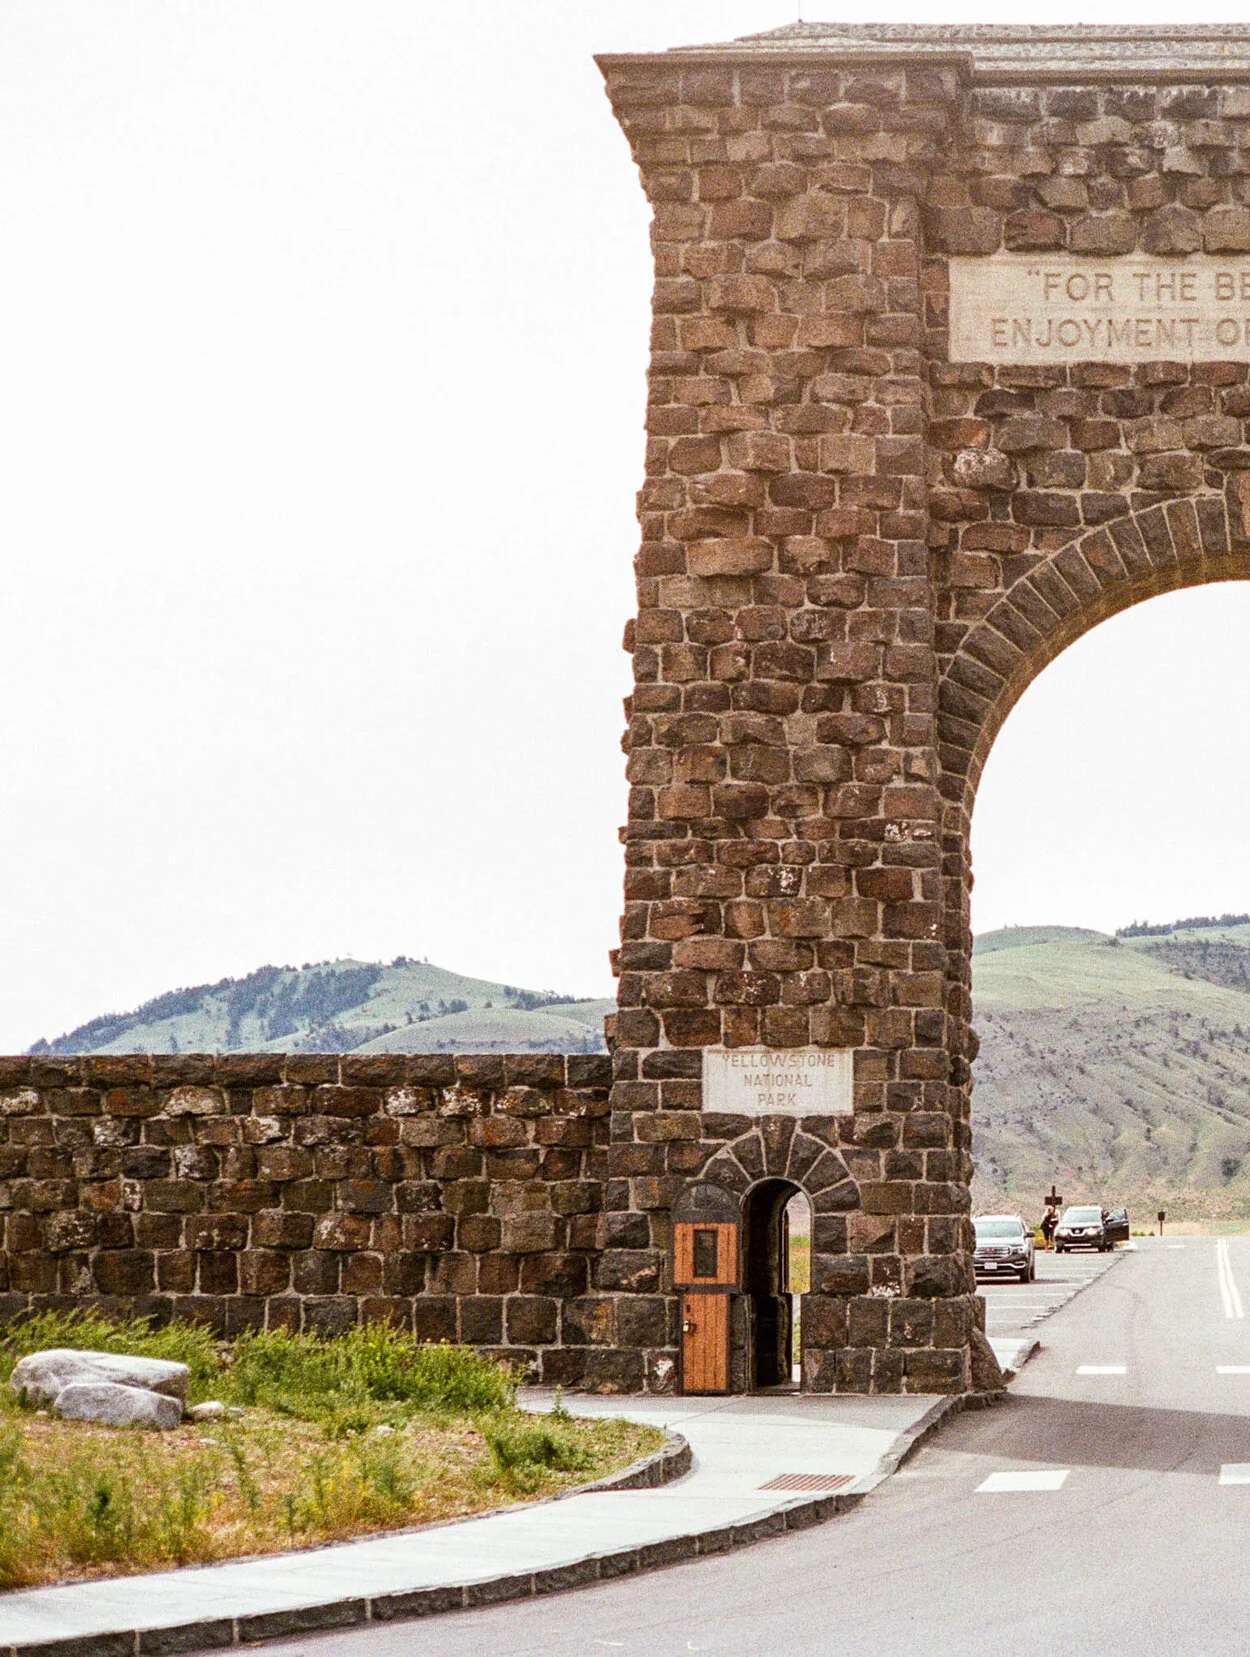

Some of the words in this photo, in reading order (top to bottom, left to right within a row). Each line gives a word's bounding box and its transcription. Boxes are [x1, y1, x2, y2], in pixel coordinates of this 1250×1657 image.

[1132, 271, 1198, 300] THE
[991, 318, 1200, 347] ENJOYMENT
[722, 1054, 835, 1068] YELLOWSTONE
[744, 1074, 813, 1087] NATIONAL
[758, 1093, 796, 1106] PARK
